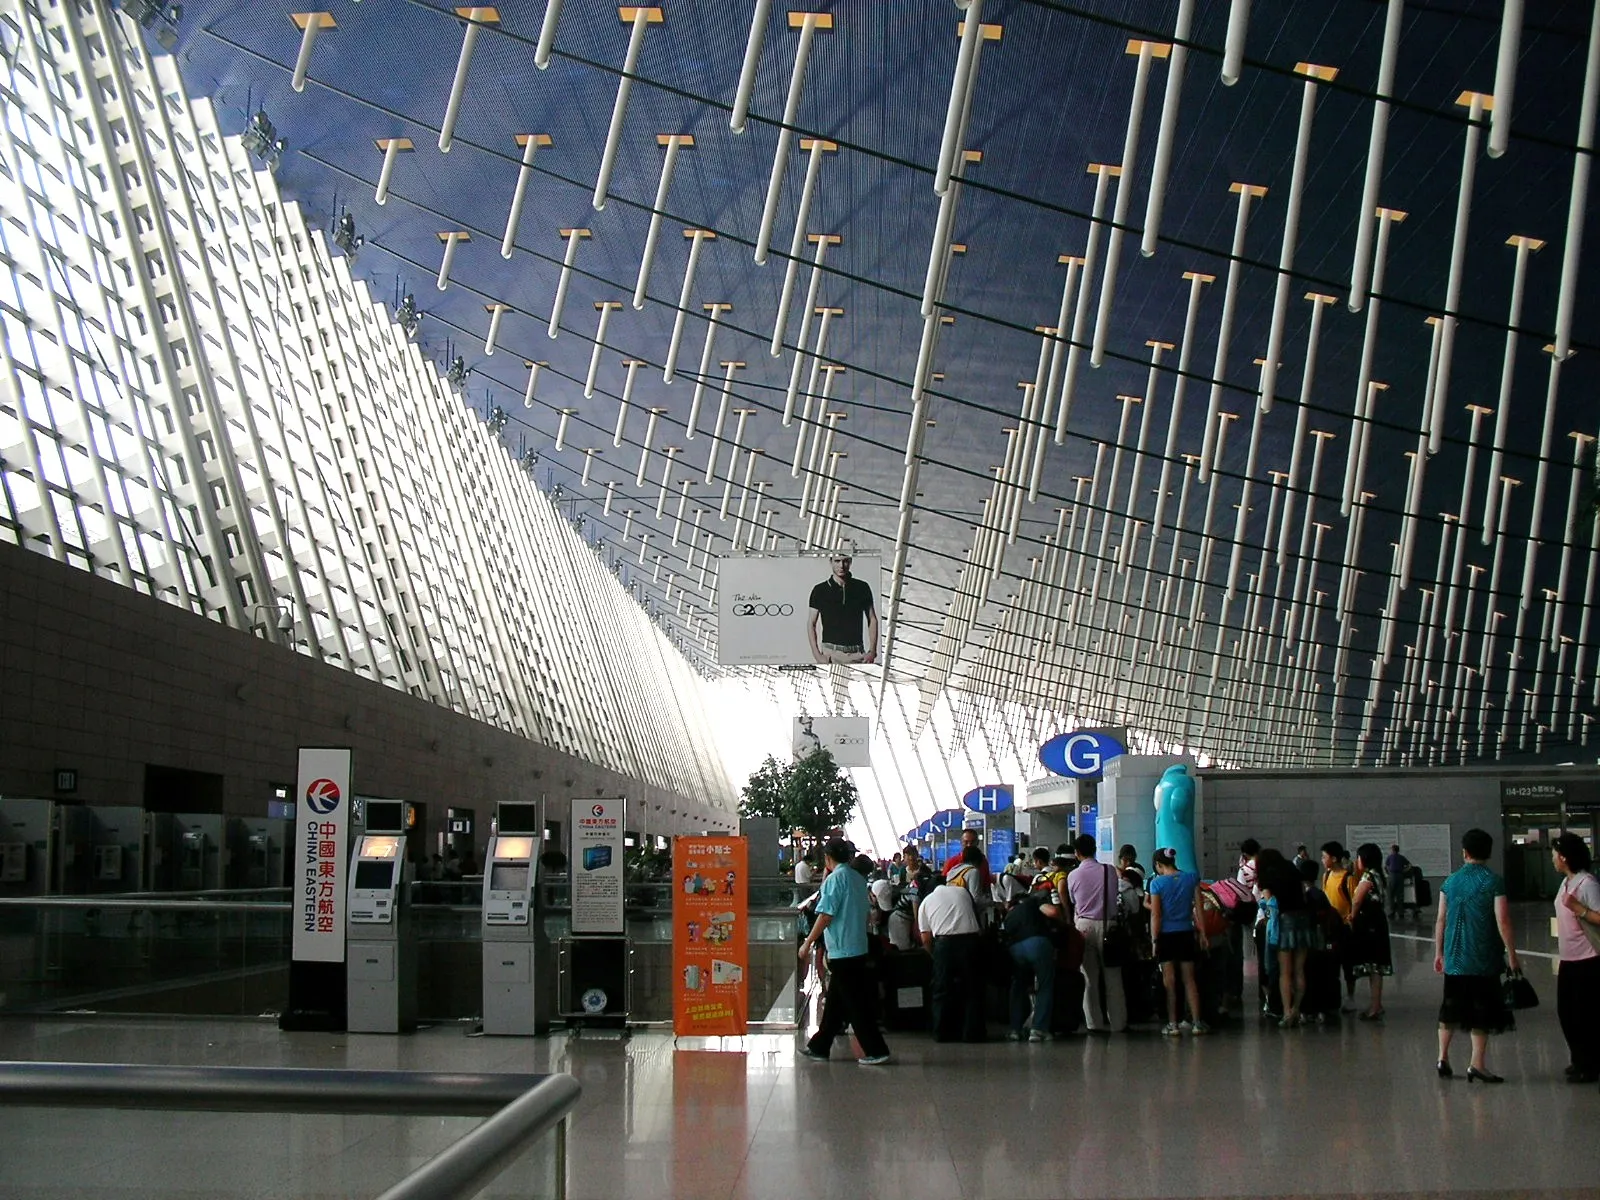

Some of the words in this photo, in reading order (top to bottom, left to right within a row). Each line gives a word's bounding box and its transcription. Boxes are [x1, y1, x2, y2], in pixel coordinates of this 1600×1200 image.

[732, 603, 794, 617] G2000
[1064, 734, 1101, 775] G
[978, 788, 997, 811] H
[929, 820, 942, 833] K
[942, 811, 952, 827] J
[306, 821, 318, 864] CHINA
[915, 828, 923, 840] L
[318, 821, 336, 933] 中國東方航空
[304, 868, 317, 932] EASTERN
